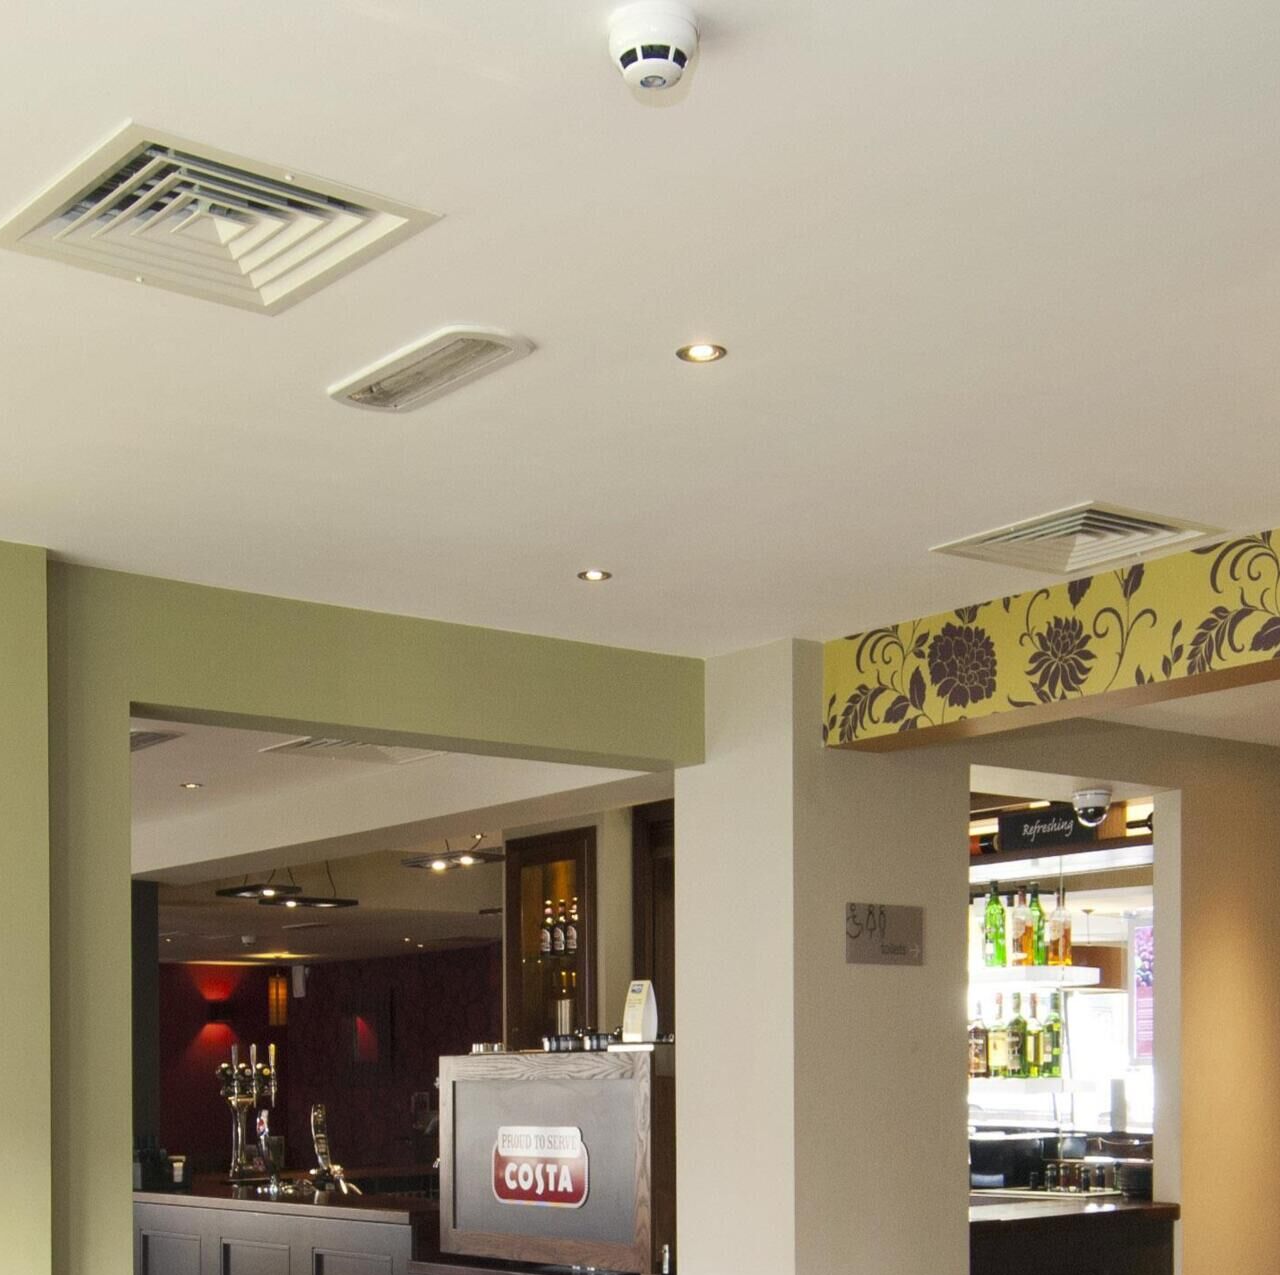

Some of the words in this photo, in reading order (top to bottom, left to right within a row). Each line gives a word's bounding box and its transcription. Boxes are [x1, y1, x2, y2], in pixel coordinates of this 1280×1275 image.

[1022, 817, 1074, 842] Refreshing
[501, 1134, 532, 1149] PROUD
[534, 1134, 546, 1149] TO
[547, 1134, 578, 1151] SERVE
[504, 1162, 573, 1196] COSTA
